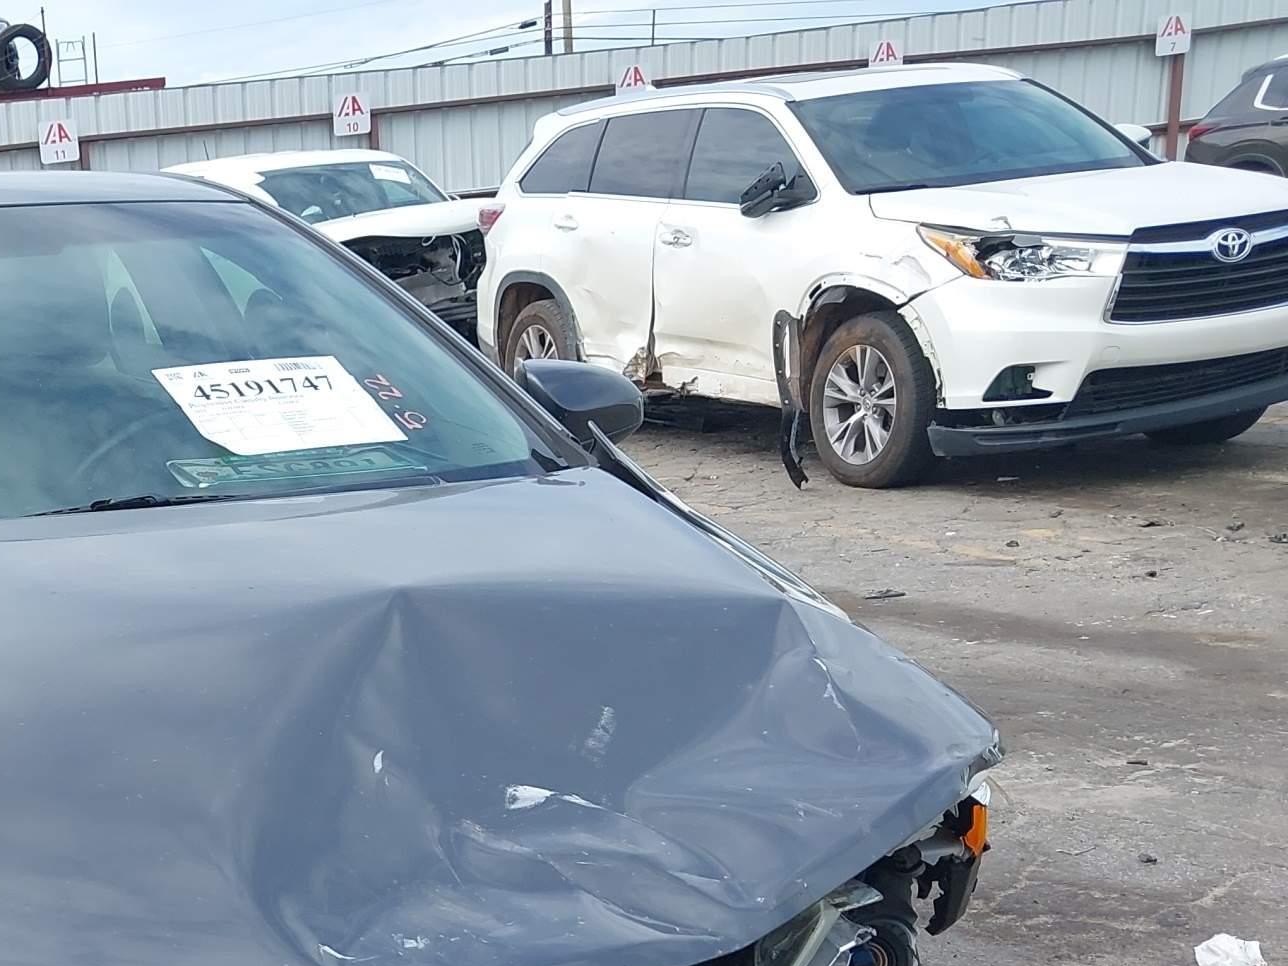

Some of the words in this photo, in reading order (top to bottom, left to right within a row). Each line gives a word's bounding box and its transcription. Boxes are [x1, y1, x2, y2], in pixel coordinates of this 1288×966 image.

[346, 121, 359, 133] 10
[55, 149, 67, 161] 11
[192, 375, 334, 401] 45191747
